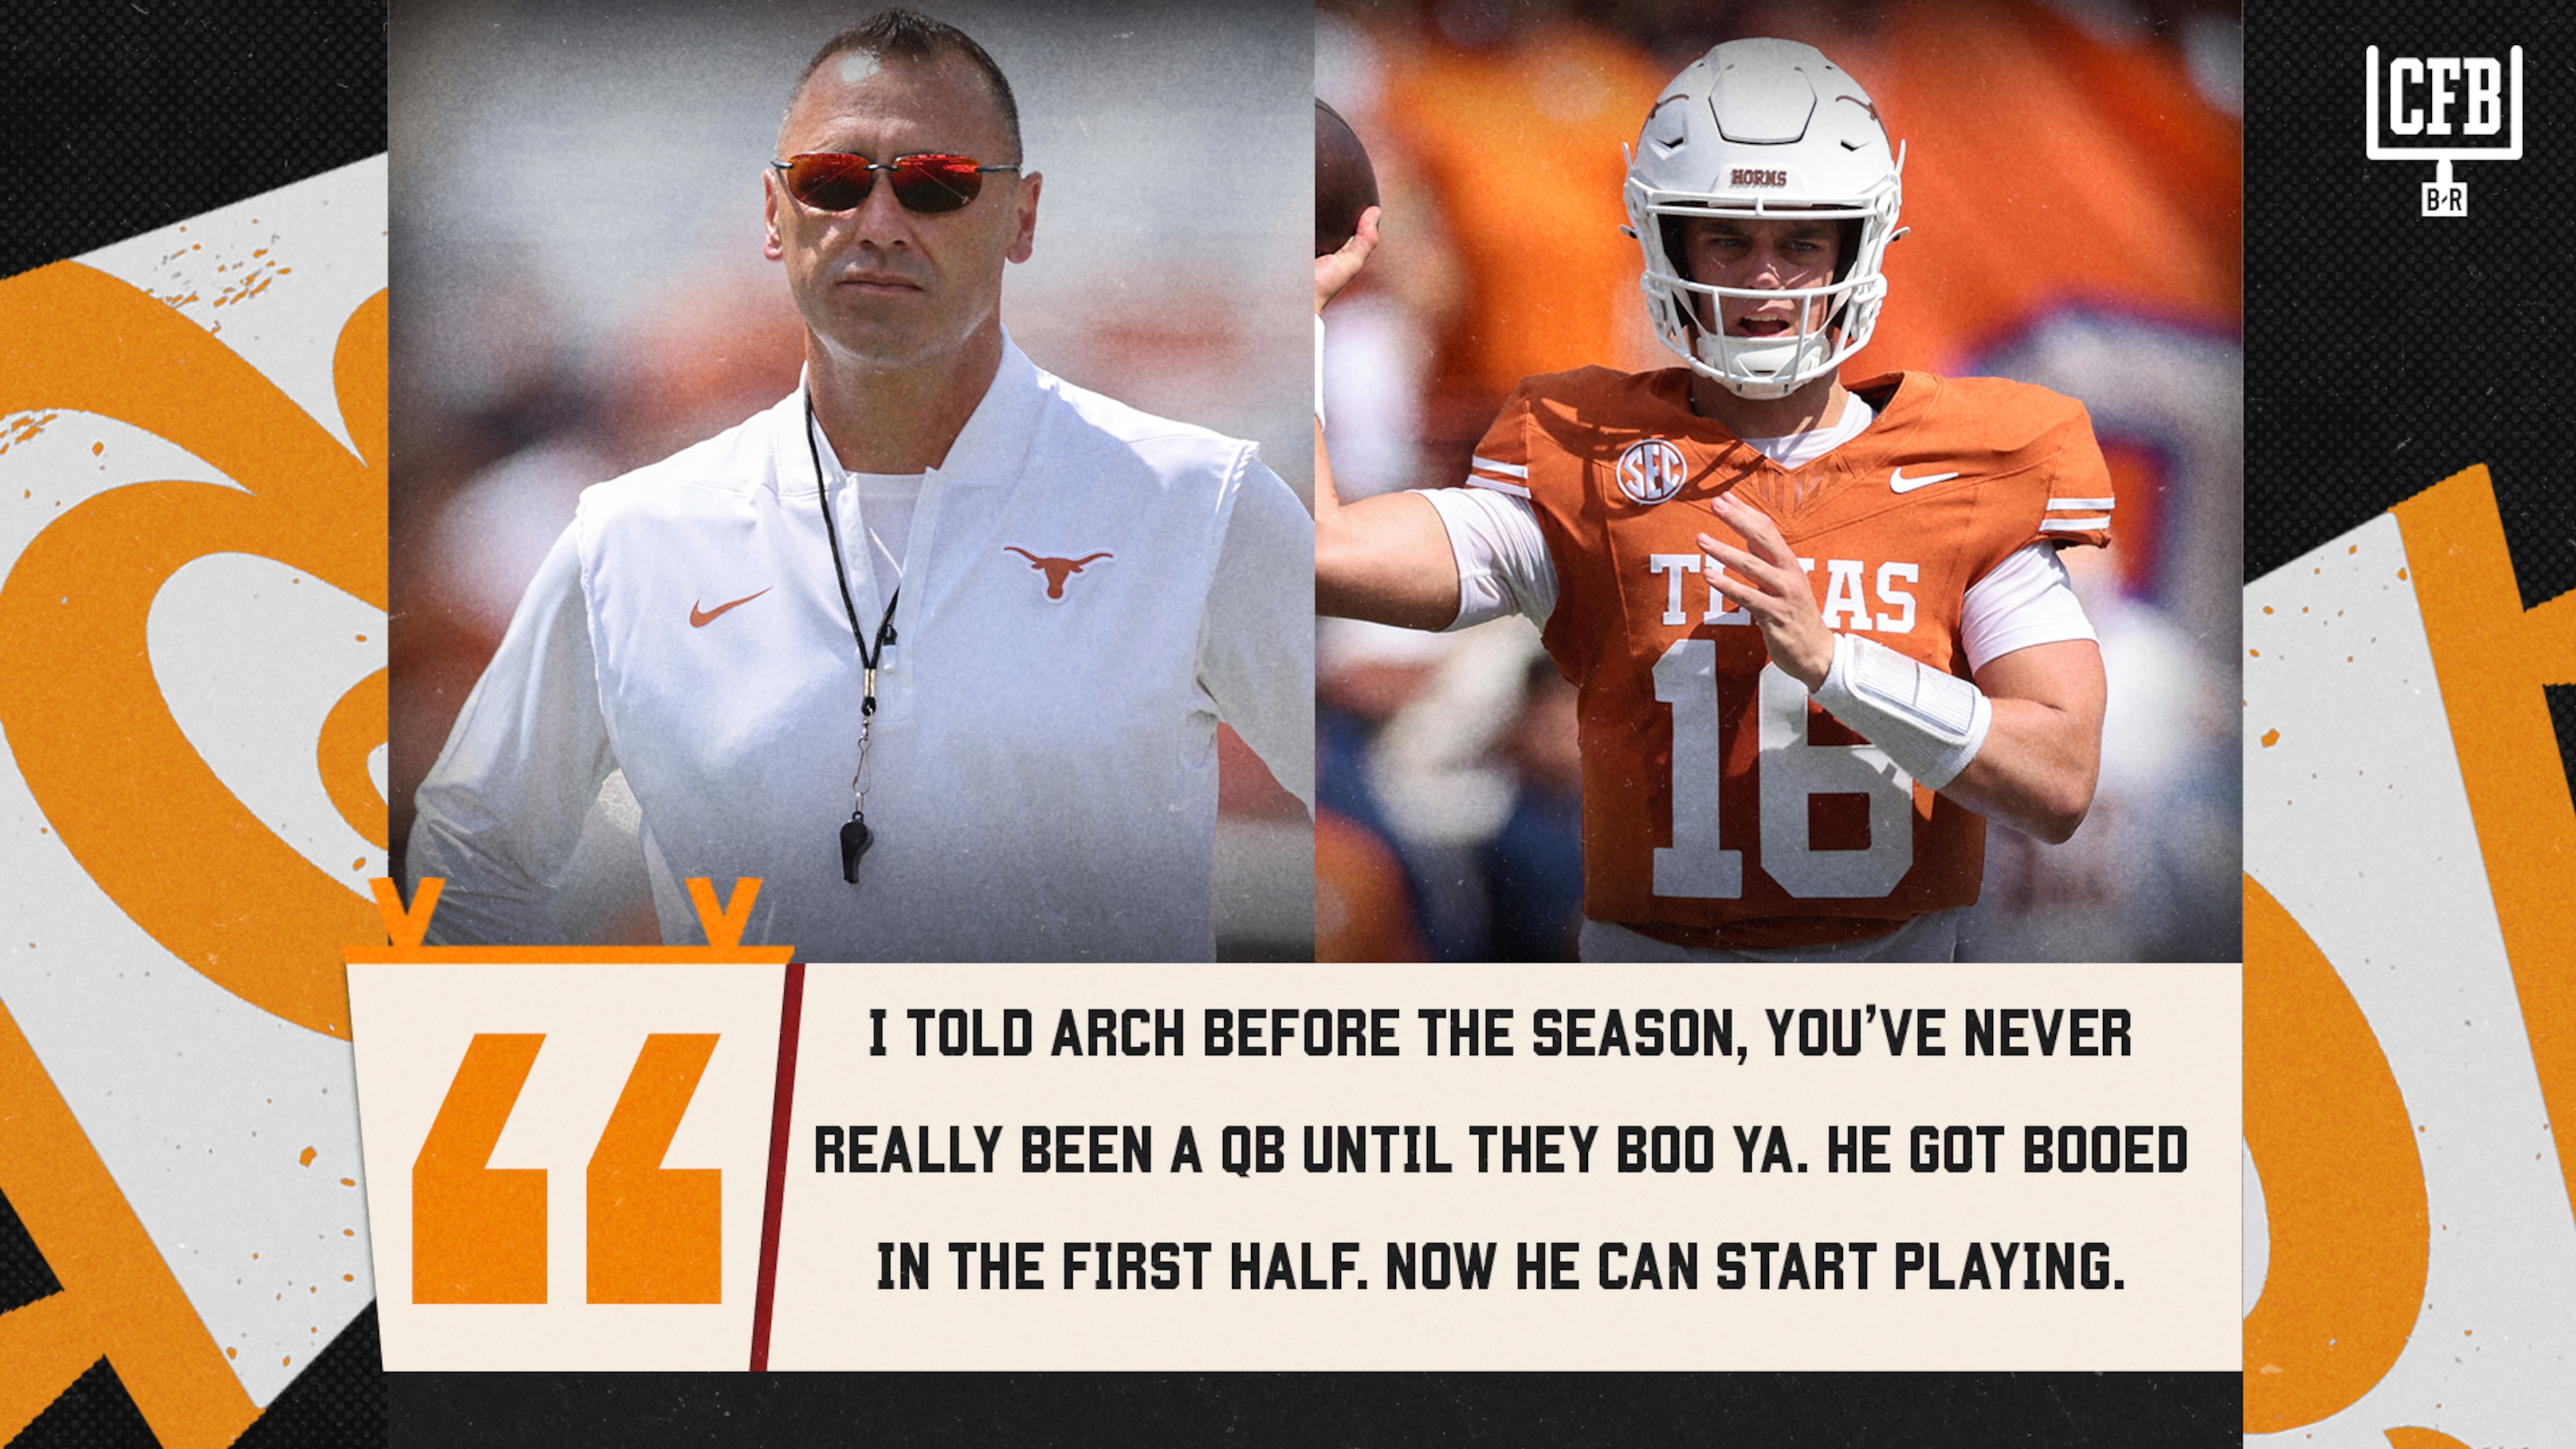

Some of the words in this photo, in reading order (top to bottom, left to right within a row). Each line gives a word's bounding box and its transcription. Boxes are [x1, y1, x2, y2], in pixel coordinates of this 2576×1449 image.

[1731, 168, 1788, 187] HORNS
[1623, 443, 1681, 499] SEC
[1649, 554, 1920, 634] TEAS
[1651, 638, 1915, 899] 16
